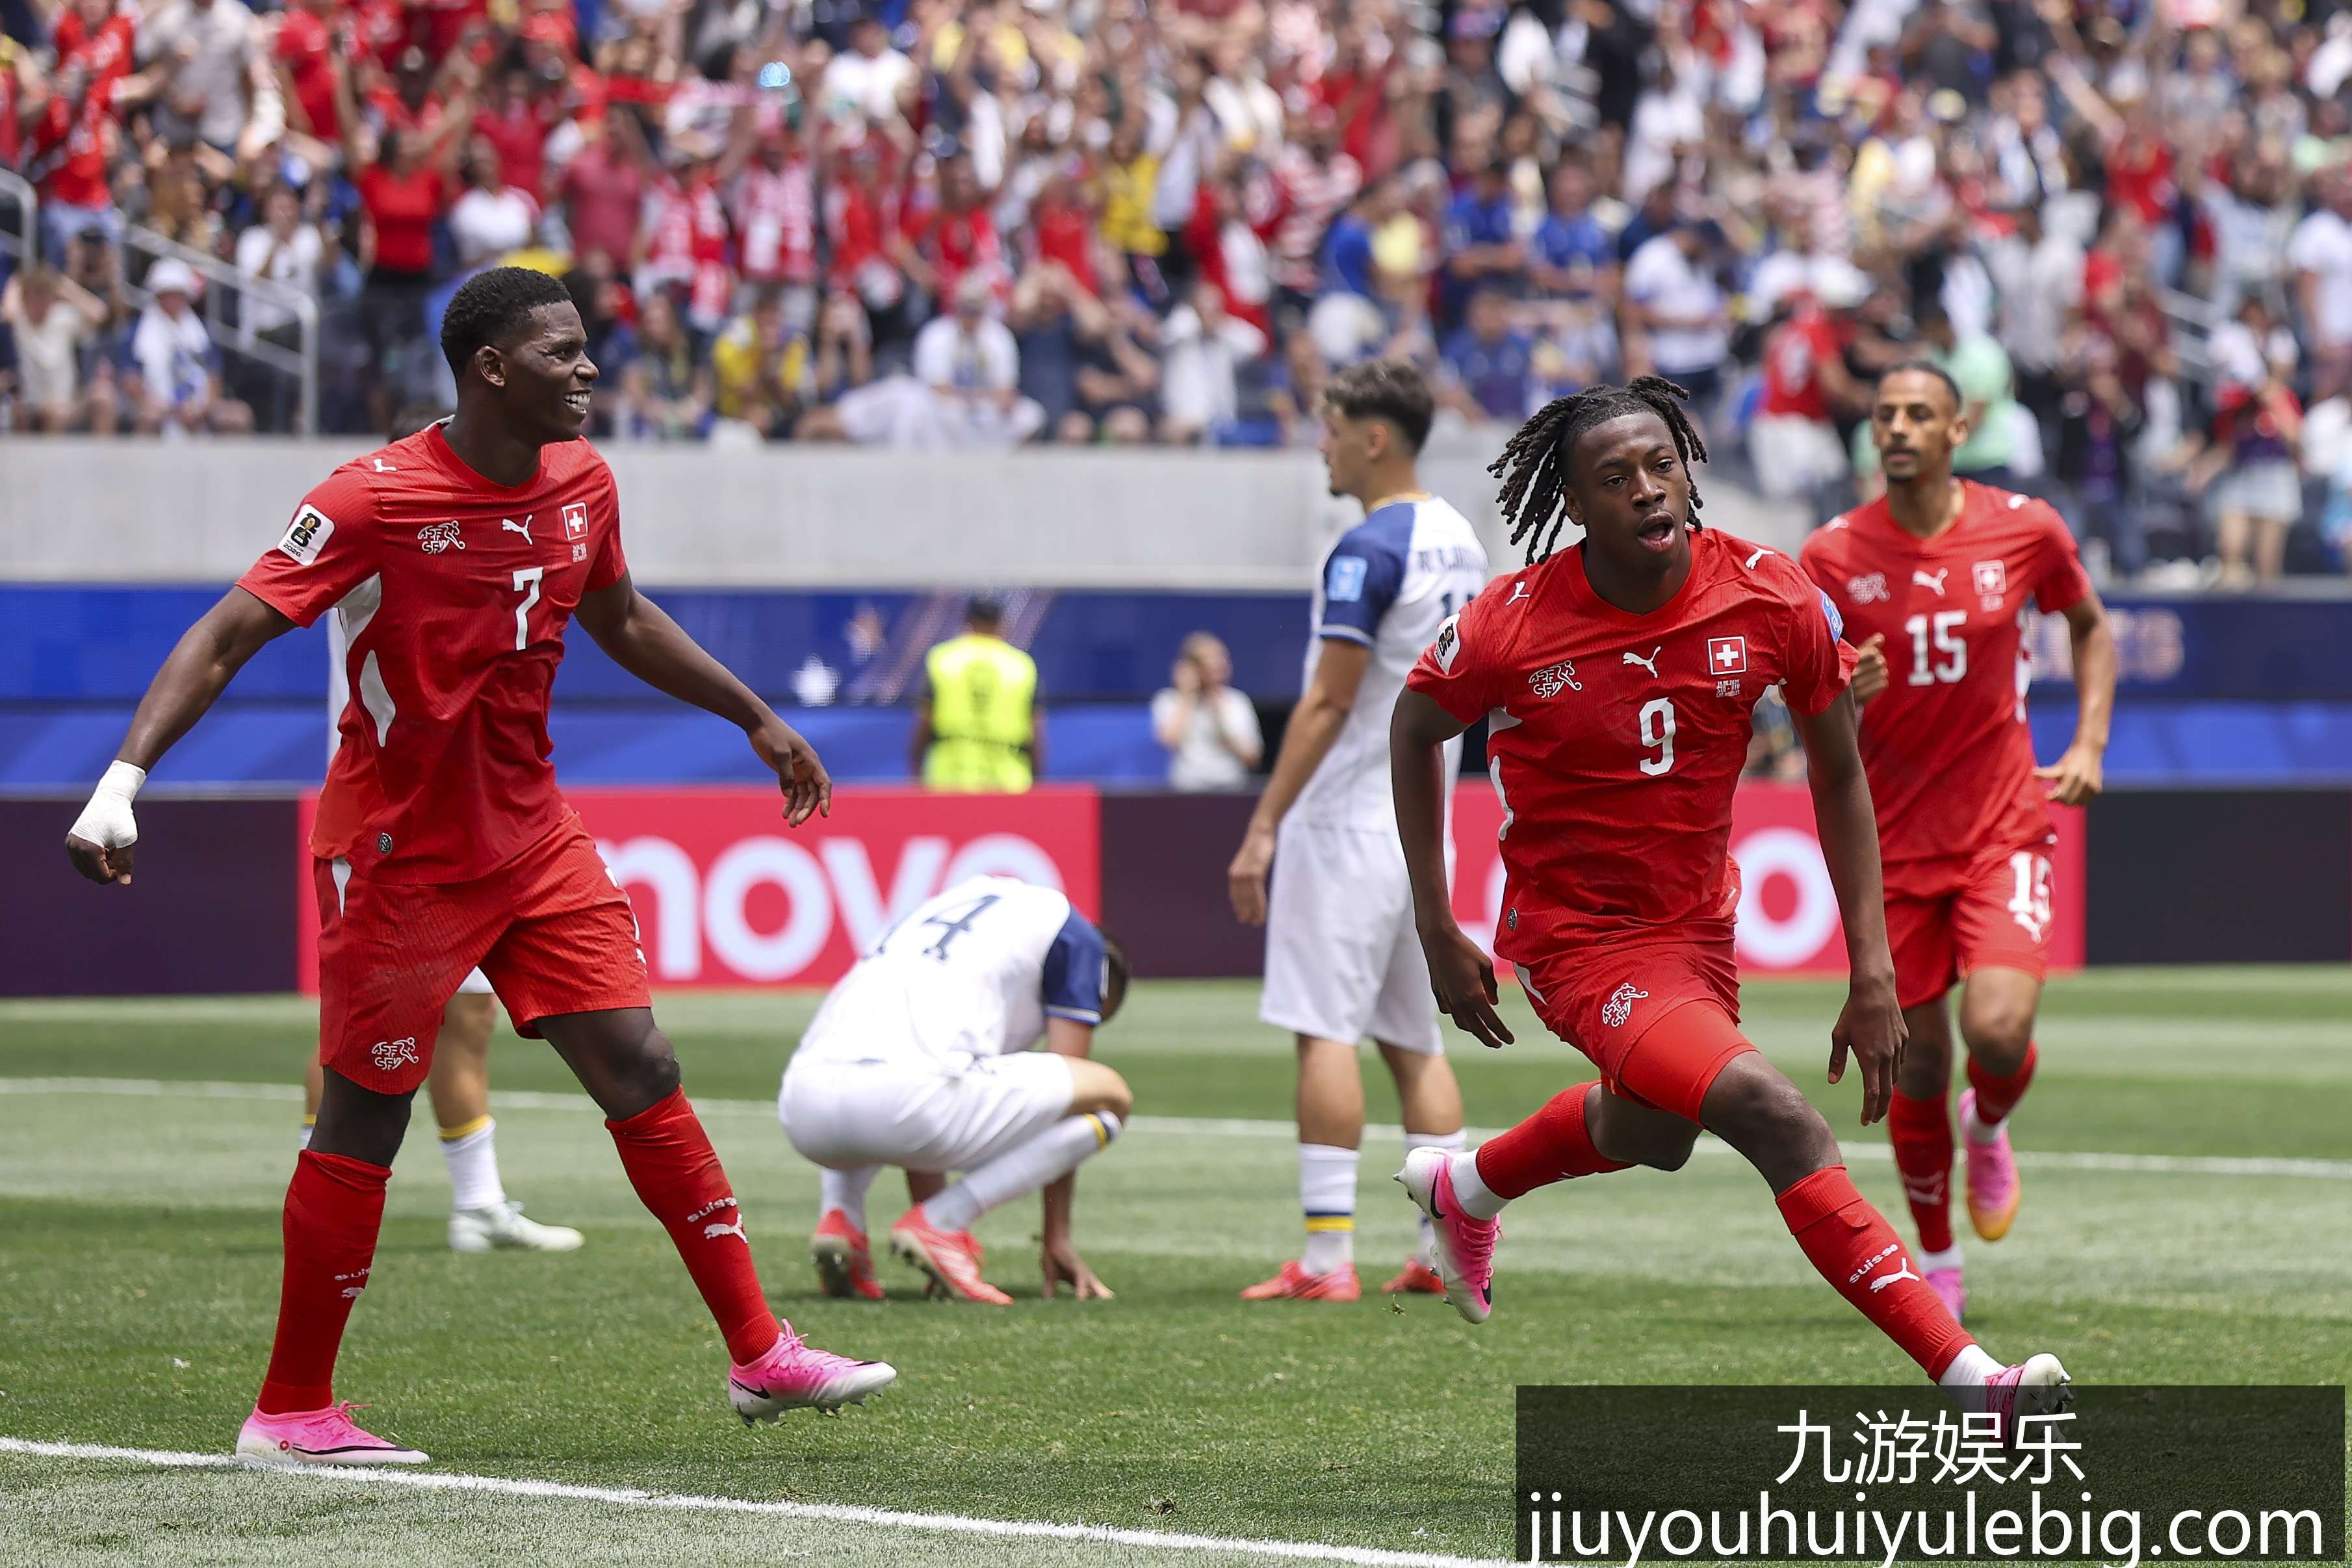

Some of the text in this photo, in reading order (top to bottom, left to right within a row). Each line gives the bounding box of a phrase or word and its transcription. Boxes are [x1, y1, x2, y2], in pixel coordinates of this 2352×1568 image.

[513, 567, 544, 650] 7
[1905, 610, 1968, 687] 15
[1639, 697, 1677, 776] 9
[2007, 851, 2052, 923] 15
[1850, 1244, 1898, 1283] suisse
